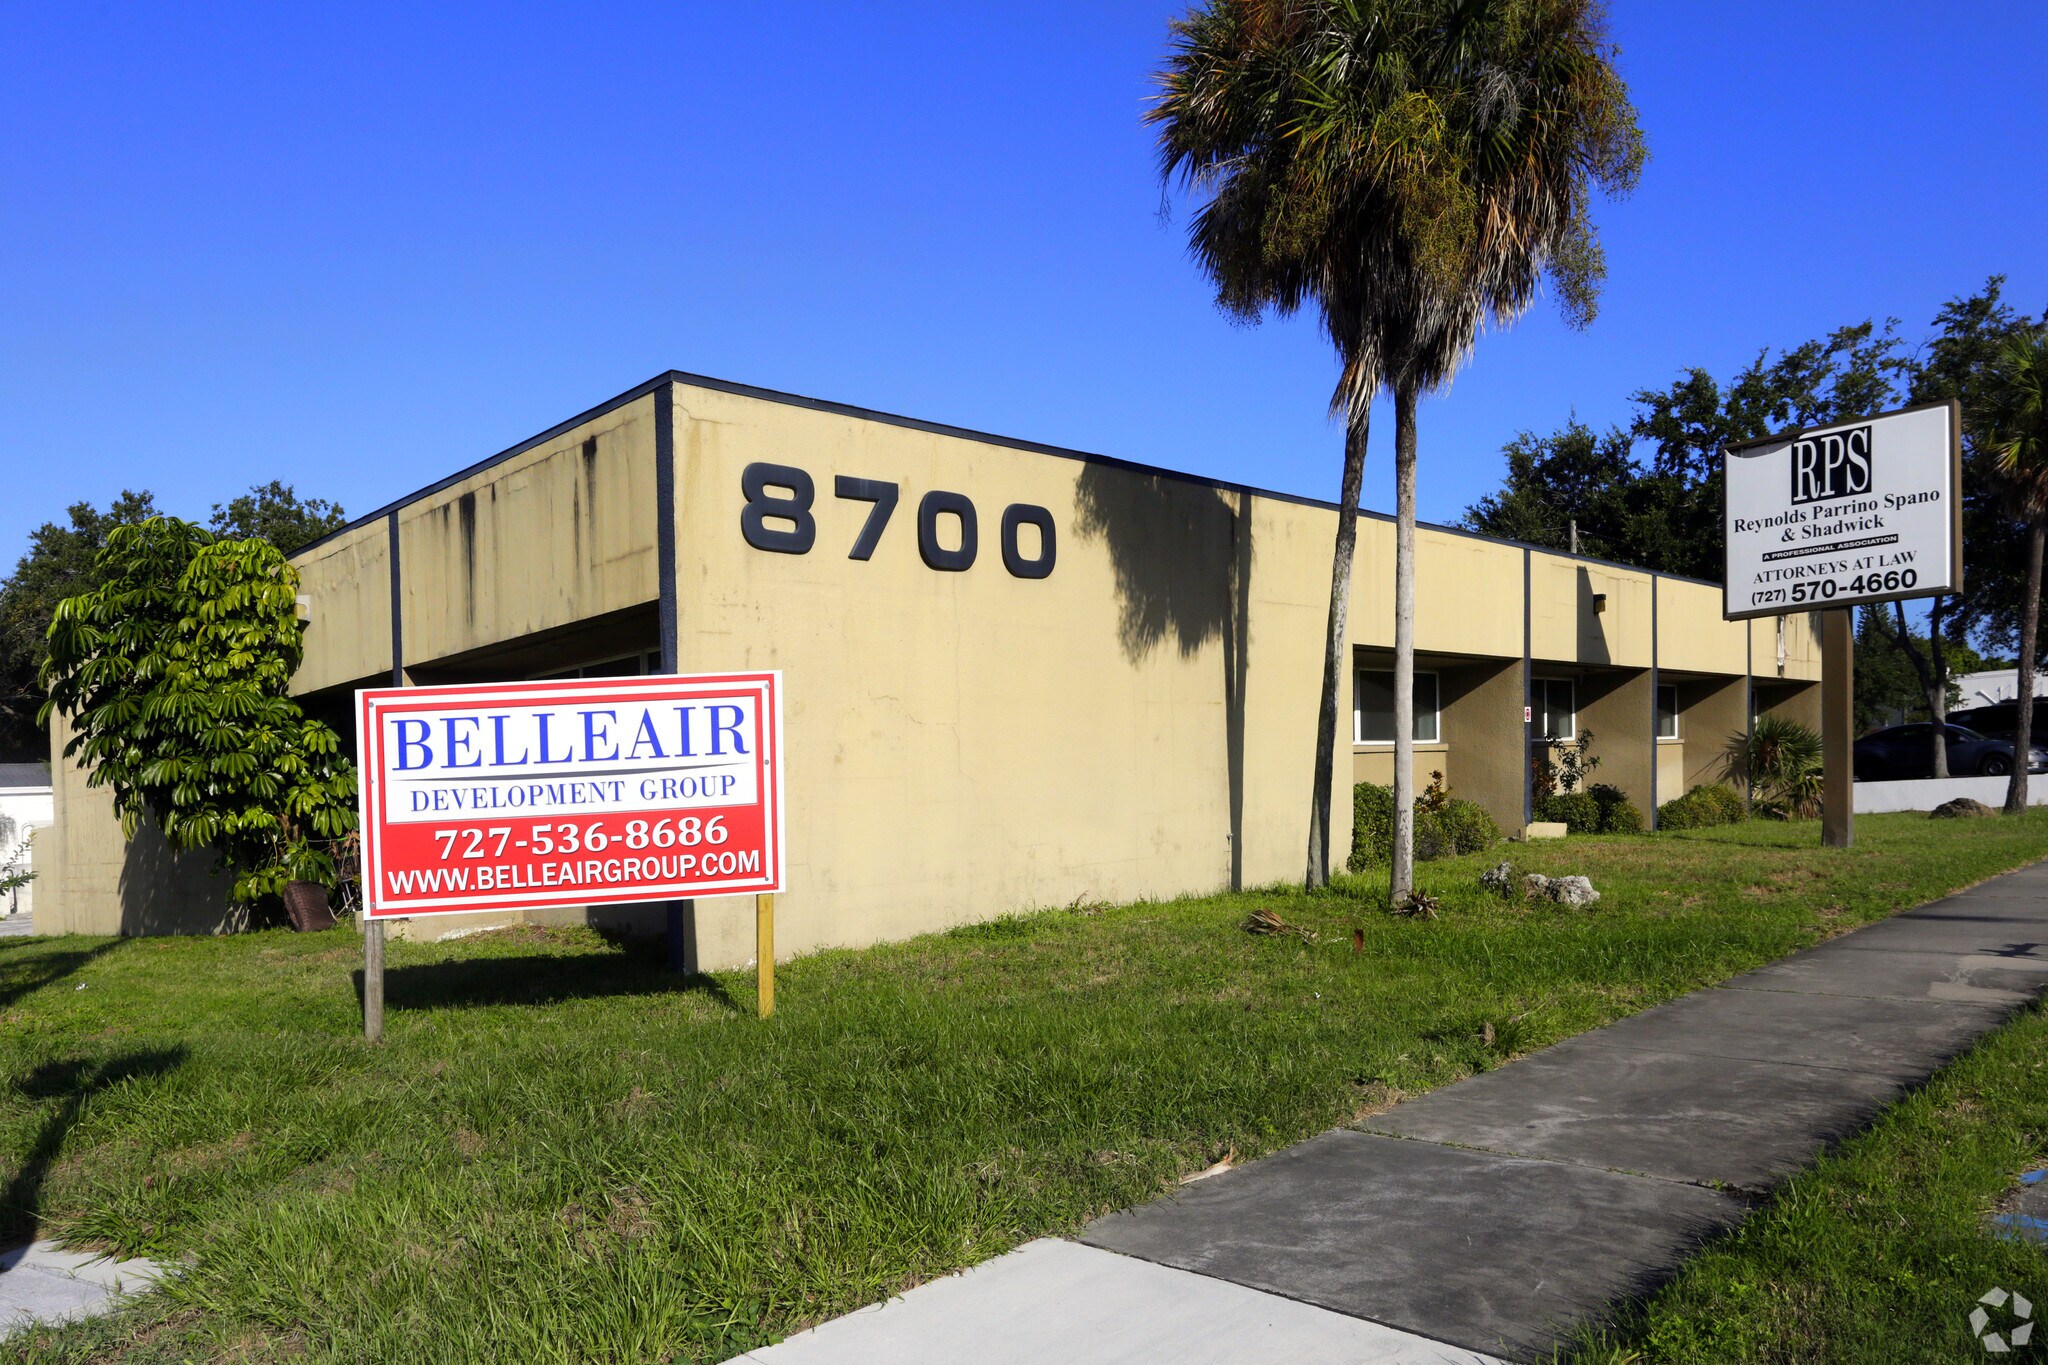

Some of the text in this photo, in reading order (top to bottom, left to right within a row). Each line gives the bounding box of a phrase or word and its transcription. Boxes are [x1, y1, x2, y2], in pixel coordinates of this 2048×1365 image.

[1793, 428, 1869, 501] RPS
[741, 462, 1056, 579] 8700
[1734, 490, 1940, 534] Reynolds Parrino Spano
[1781, 514, 1884, 542] & Shadwick
[1753, 551, 1917, 584] ATTORNEYS AT LAW
[1772, 545, 1835, 559] PROFESSIONAL
[1837, 535, 1897, 550] ASSOCIATION
[1751, 568, 1917, 606] (727) 570-4660
[390, 704, 750, 771] BELLEAIR
[410, 774, 736, 812] DEVELOPMENT GROUP
[434, 815, 729, 860] 727-536-8686
[388, 850, 760, 895] WWW.BELLEAIRGROUP.COM
